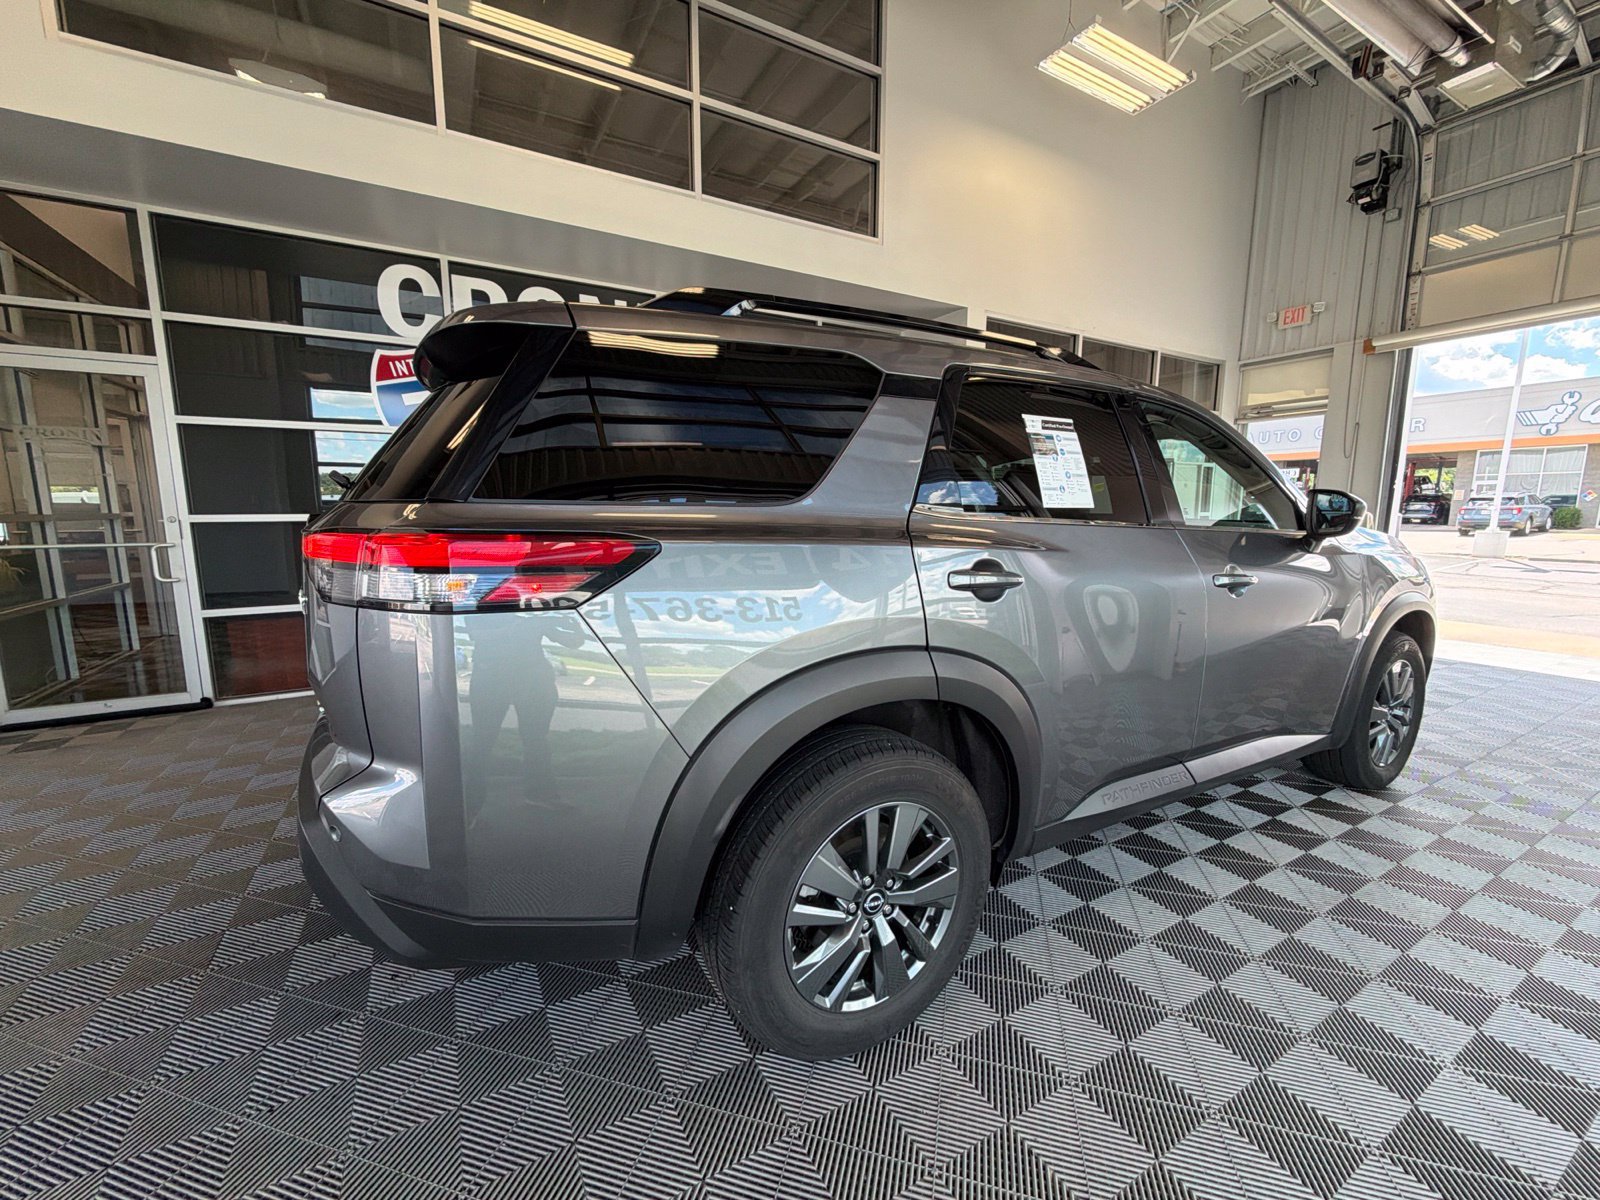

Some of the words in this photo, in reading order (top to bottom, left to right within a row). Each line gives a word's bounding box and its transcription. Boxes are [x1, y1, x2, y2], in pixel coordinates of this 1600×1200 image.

[1283, 305, 1306, 325] EXIT
[388, 358, 416, 377] INT
[1102, 770, 1188, 805] PATHFINDER
